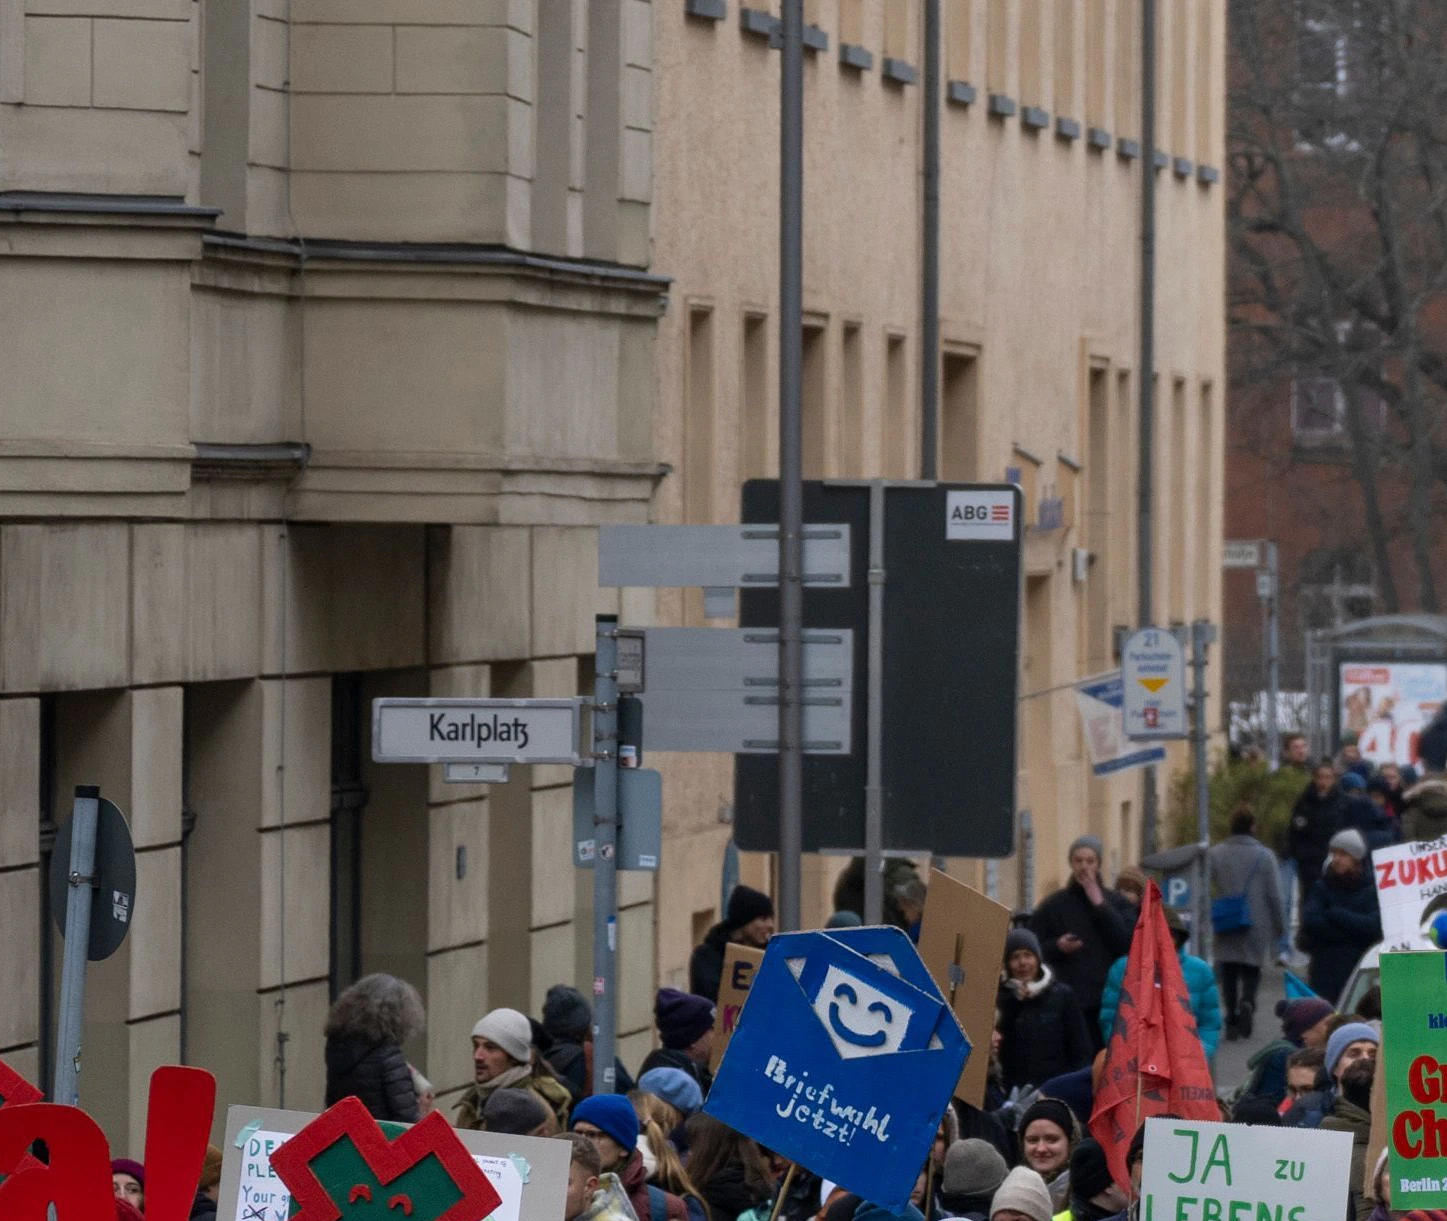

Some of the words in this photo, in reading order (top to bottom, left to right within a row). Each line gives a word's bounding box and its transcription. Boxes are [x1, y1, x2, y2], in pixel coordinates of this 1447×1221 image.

[952, 505, 987, 521] ABG
[1144, 633, 1160, 647] 21
[429, 713, 529, 749] Karlplatz
[764, 1055, 891, 1142] Briefwahl
[776, 1093, 857, 1146] jetzt!
[1168, 1129, 1232, 1186] JA
[243, 1186, 276, 1204] Your
[1401, 1177, 1440, 1193] Berlin
